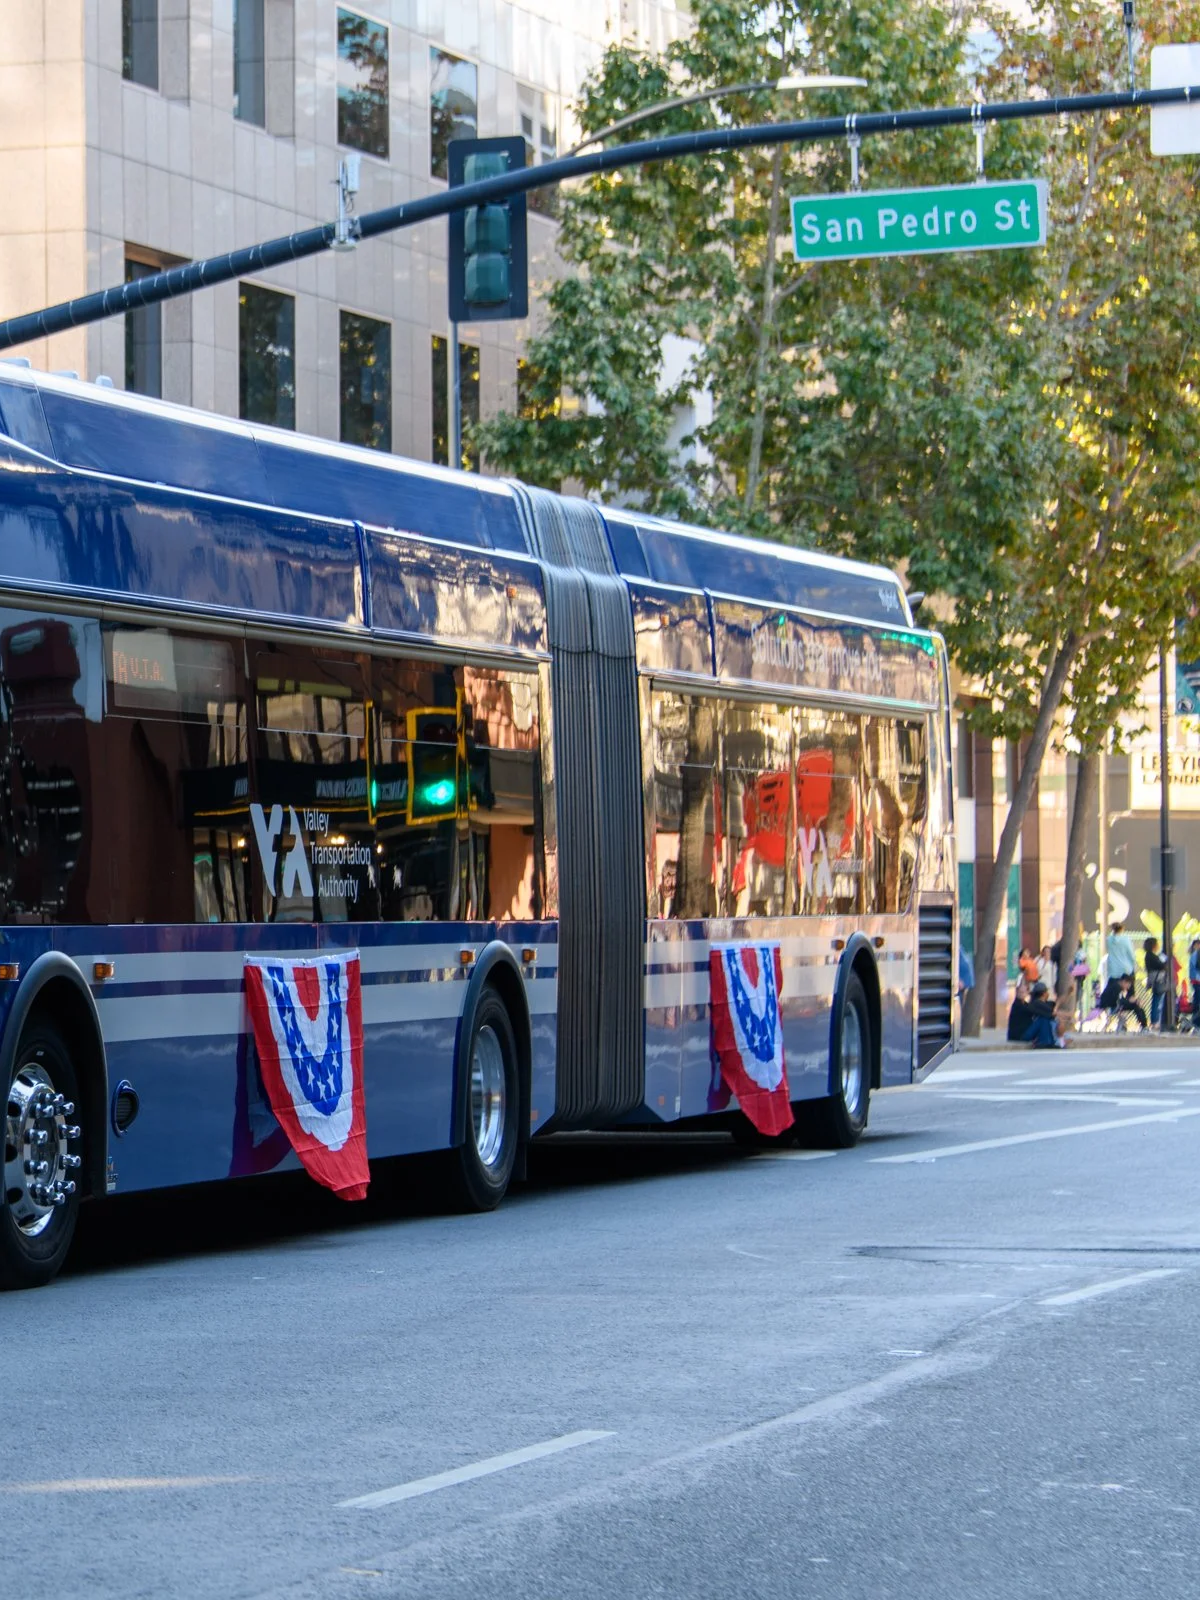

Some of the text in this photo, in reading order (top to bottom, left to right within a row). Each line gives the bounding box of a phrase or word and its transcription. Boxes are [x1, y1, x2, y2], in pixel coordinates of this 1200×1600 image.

[801, 199, 1031, 245] San Pedro St
[1180, 756, 1200, 770] YI
[303, 808, 330, 838] Valley
[310, 841, 371, 869] Transportation
[318, 874, 359, 904] Authority
